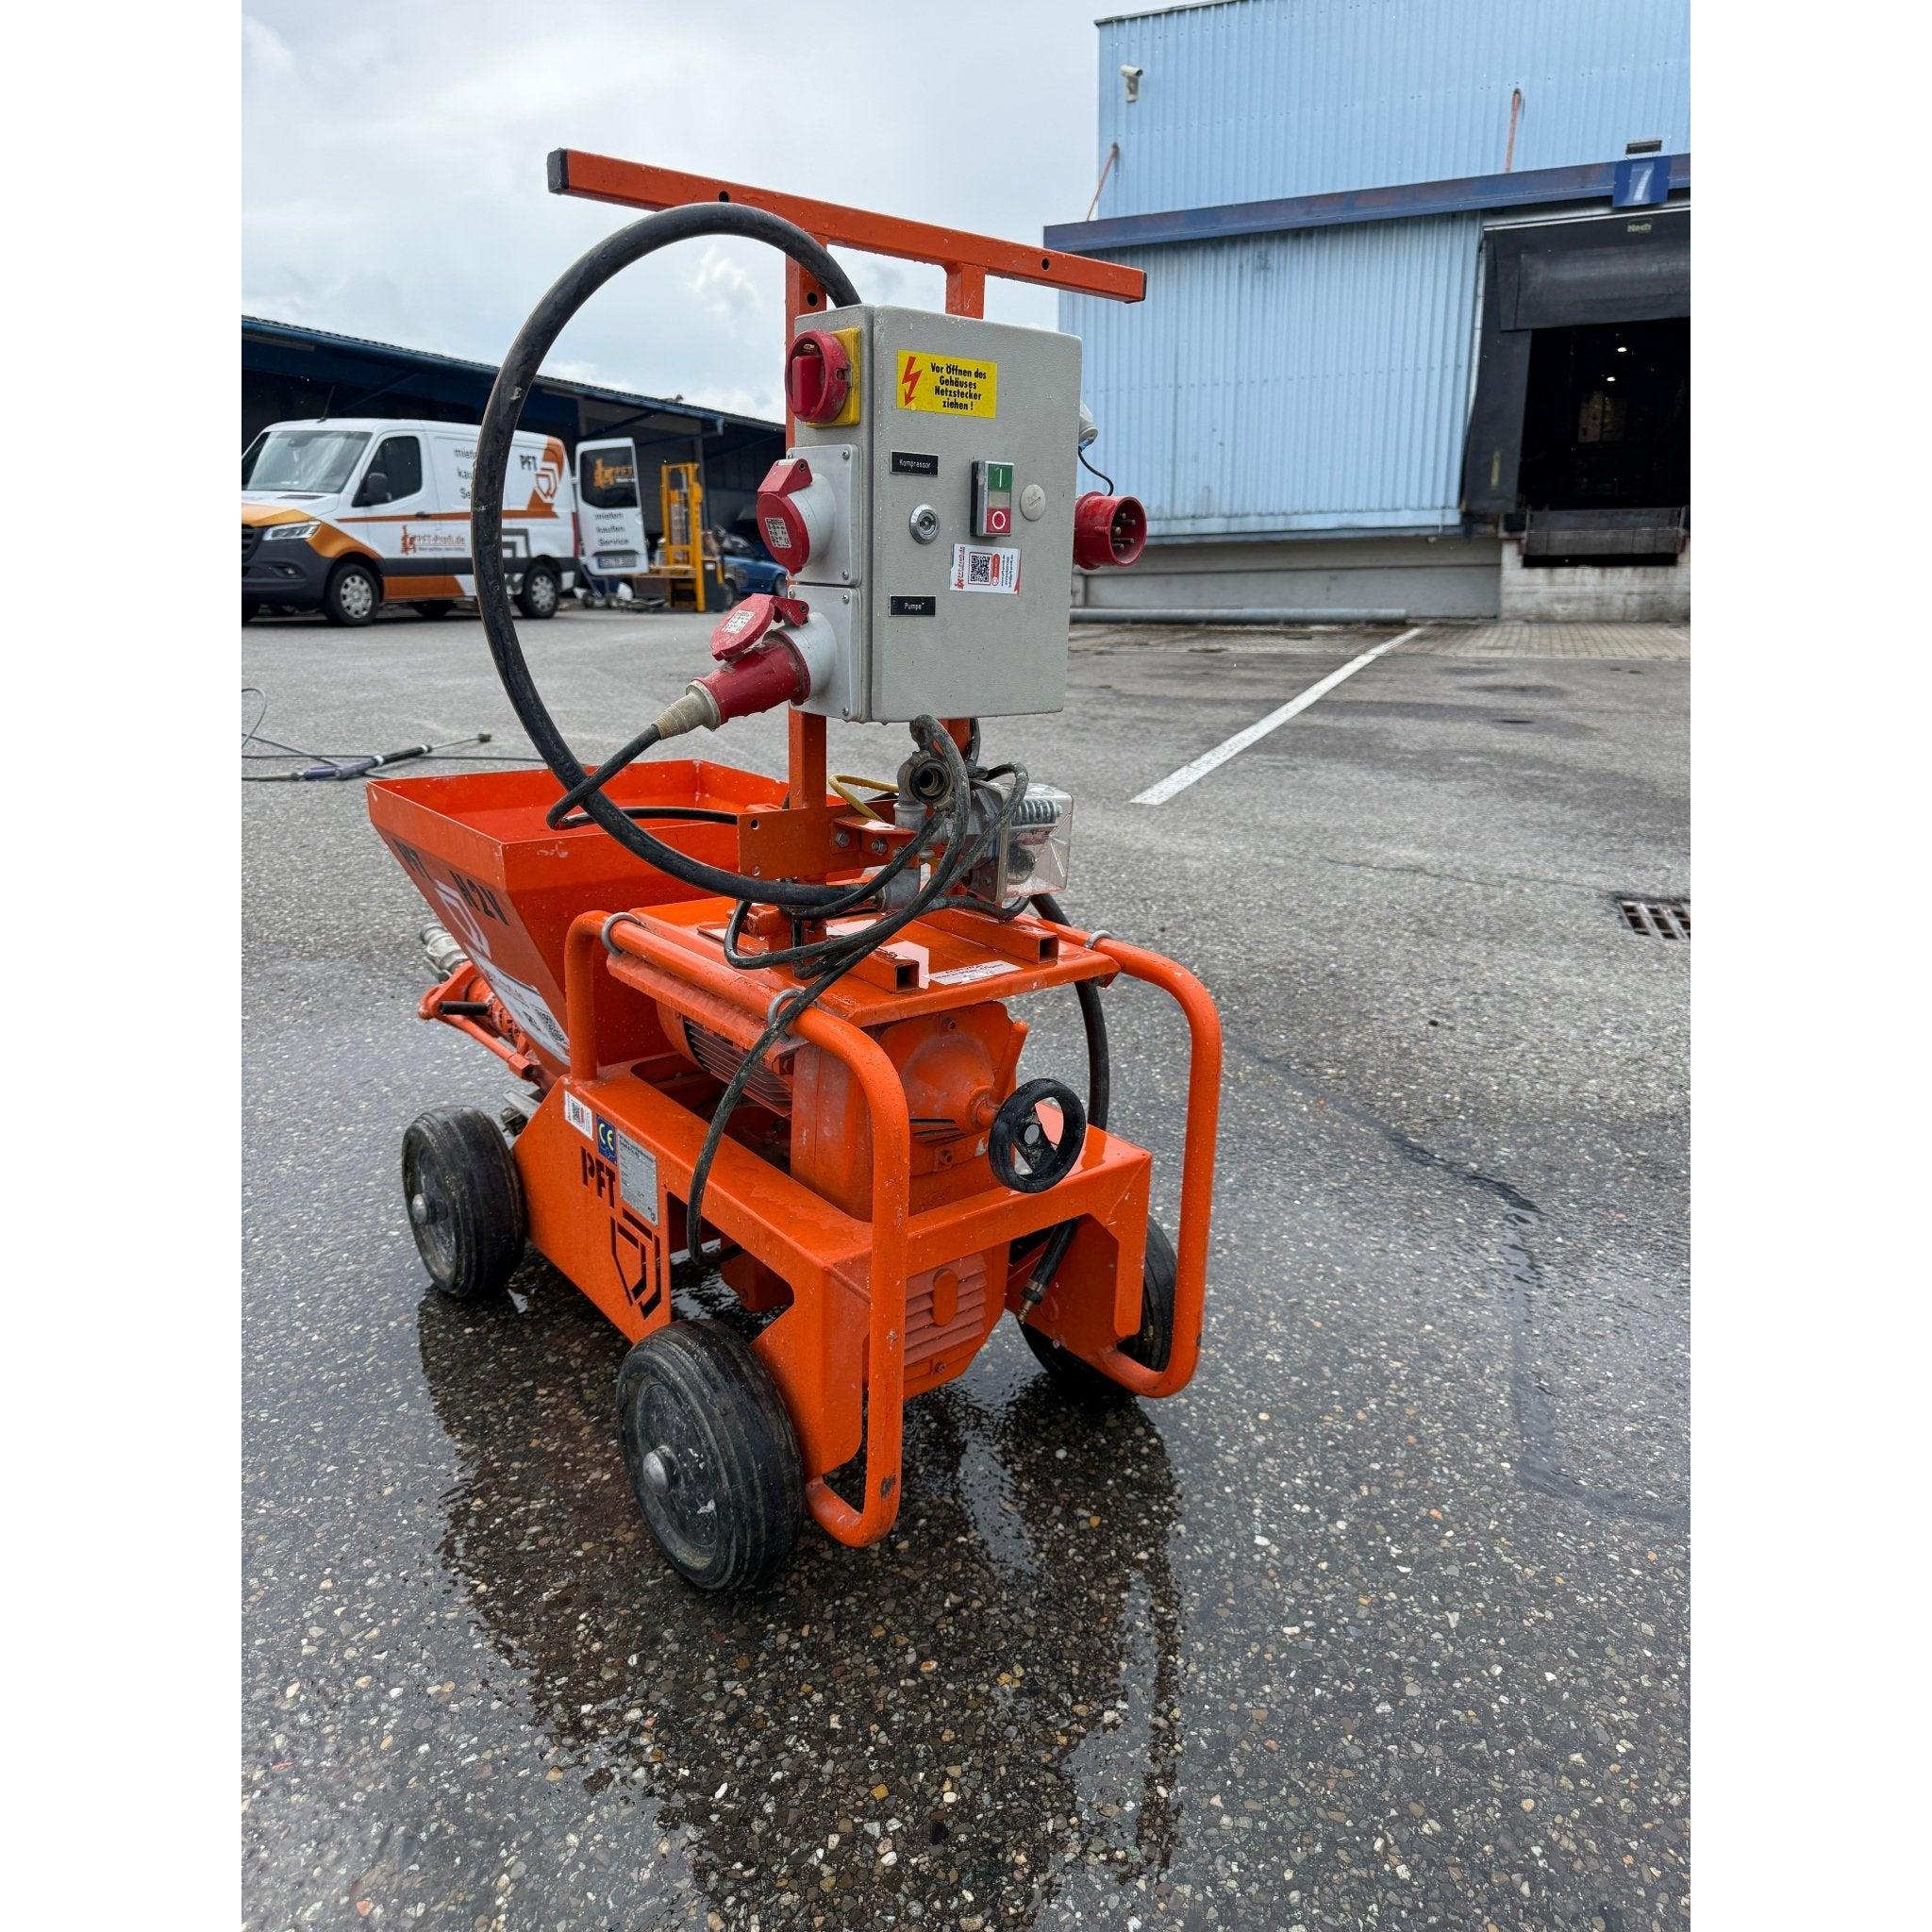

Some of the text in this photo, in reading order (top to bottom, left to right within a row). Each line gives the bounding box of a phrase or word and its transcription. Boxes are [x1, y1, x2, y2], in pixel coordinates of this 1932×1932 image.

[930, 361, 987, 379] Vor Öffnen des
[939, 375, 977, 390] Gehäuses
[934, 385, 982, 401] Netzstecker
[942, 397, 969, 410] ziehen
[520, 454, 538, 472] PFT
[899, 458, 931, 469] Kompressor
[904, 602, 923, 611] Pumpe
[580, 1145, 616, 1209] PFT
